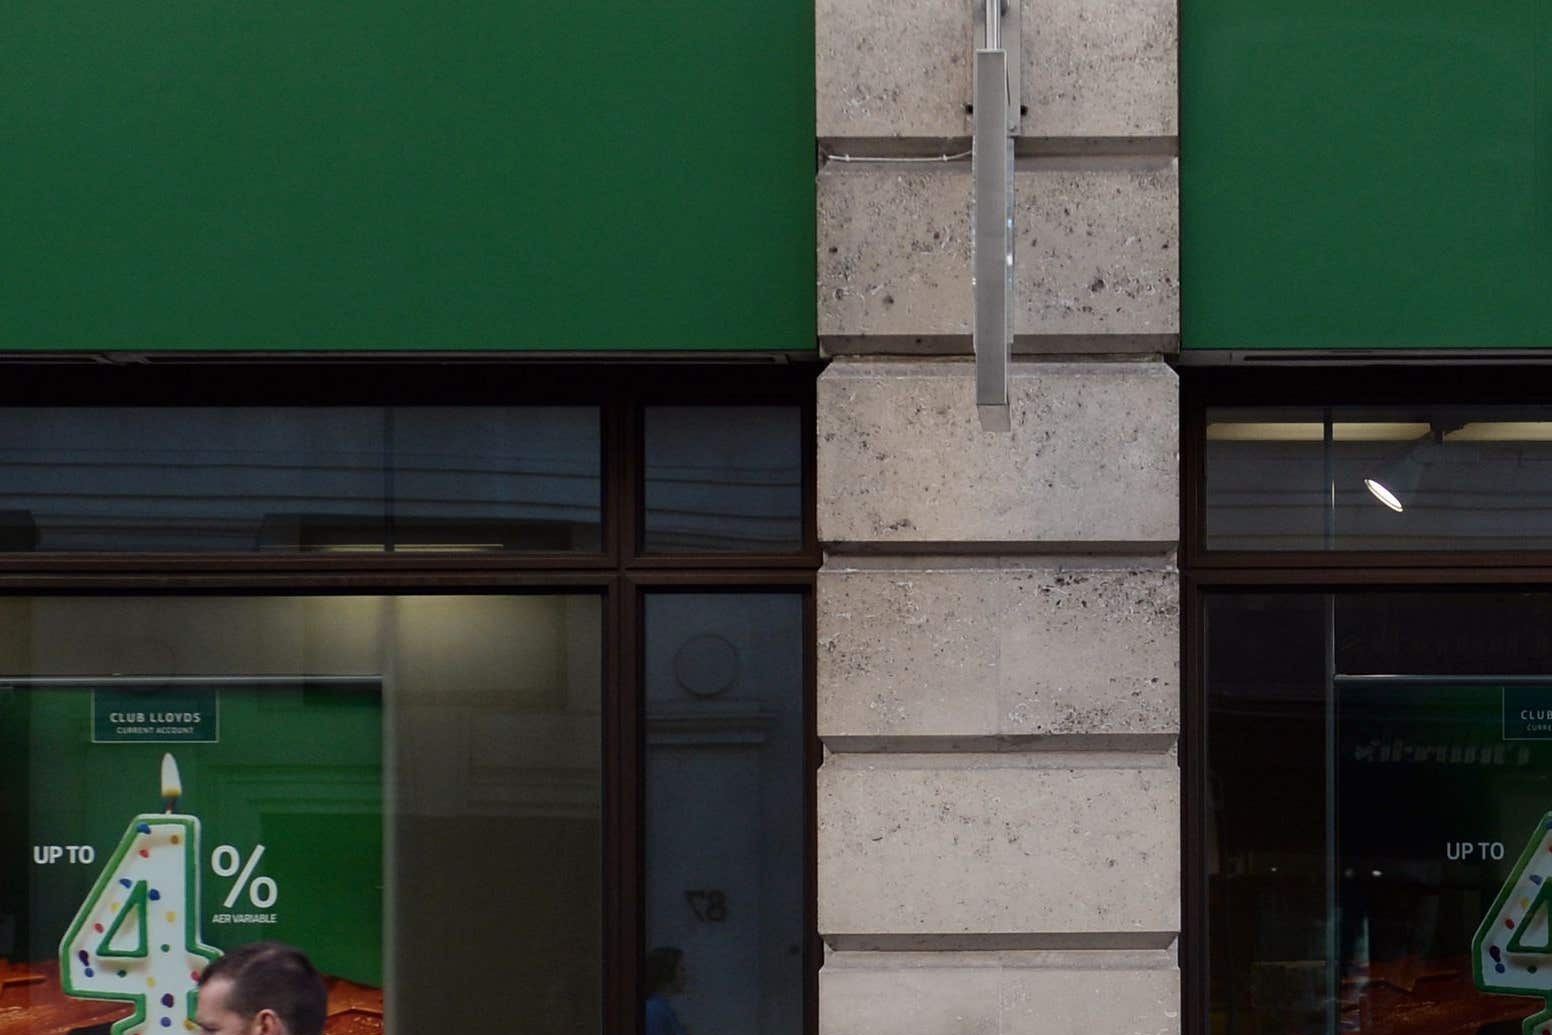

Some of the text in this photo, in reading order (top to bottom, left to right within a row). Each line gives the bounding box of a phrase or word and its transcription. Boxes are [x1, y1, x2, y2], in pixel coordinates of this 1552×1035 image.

[109, 712, 201, 723] CLUB LLOYDS
[116, 726, 194, 734] CURRENT ACCOUNT
[33, 845, 95, 865] UP TO
[1446, 842, 1505, 861] UP TO
[212, 913, 279, 924] AER VARIABLE
